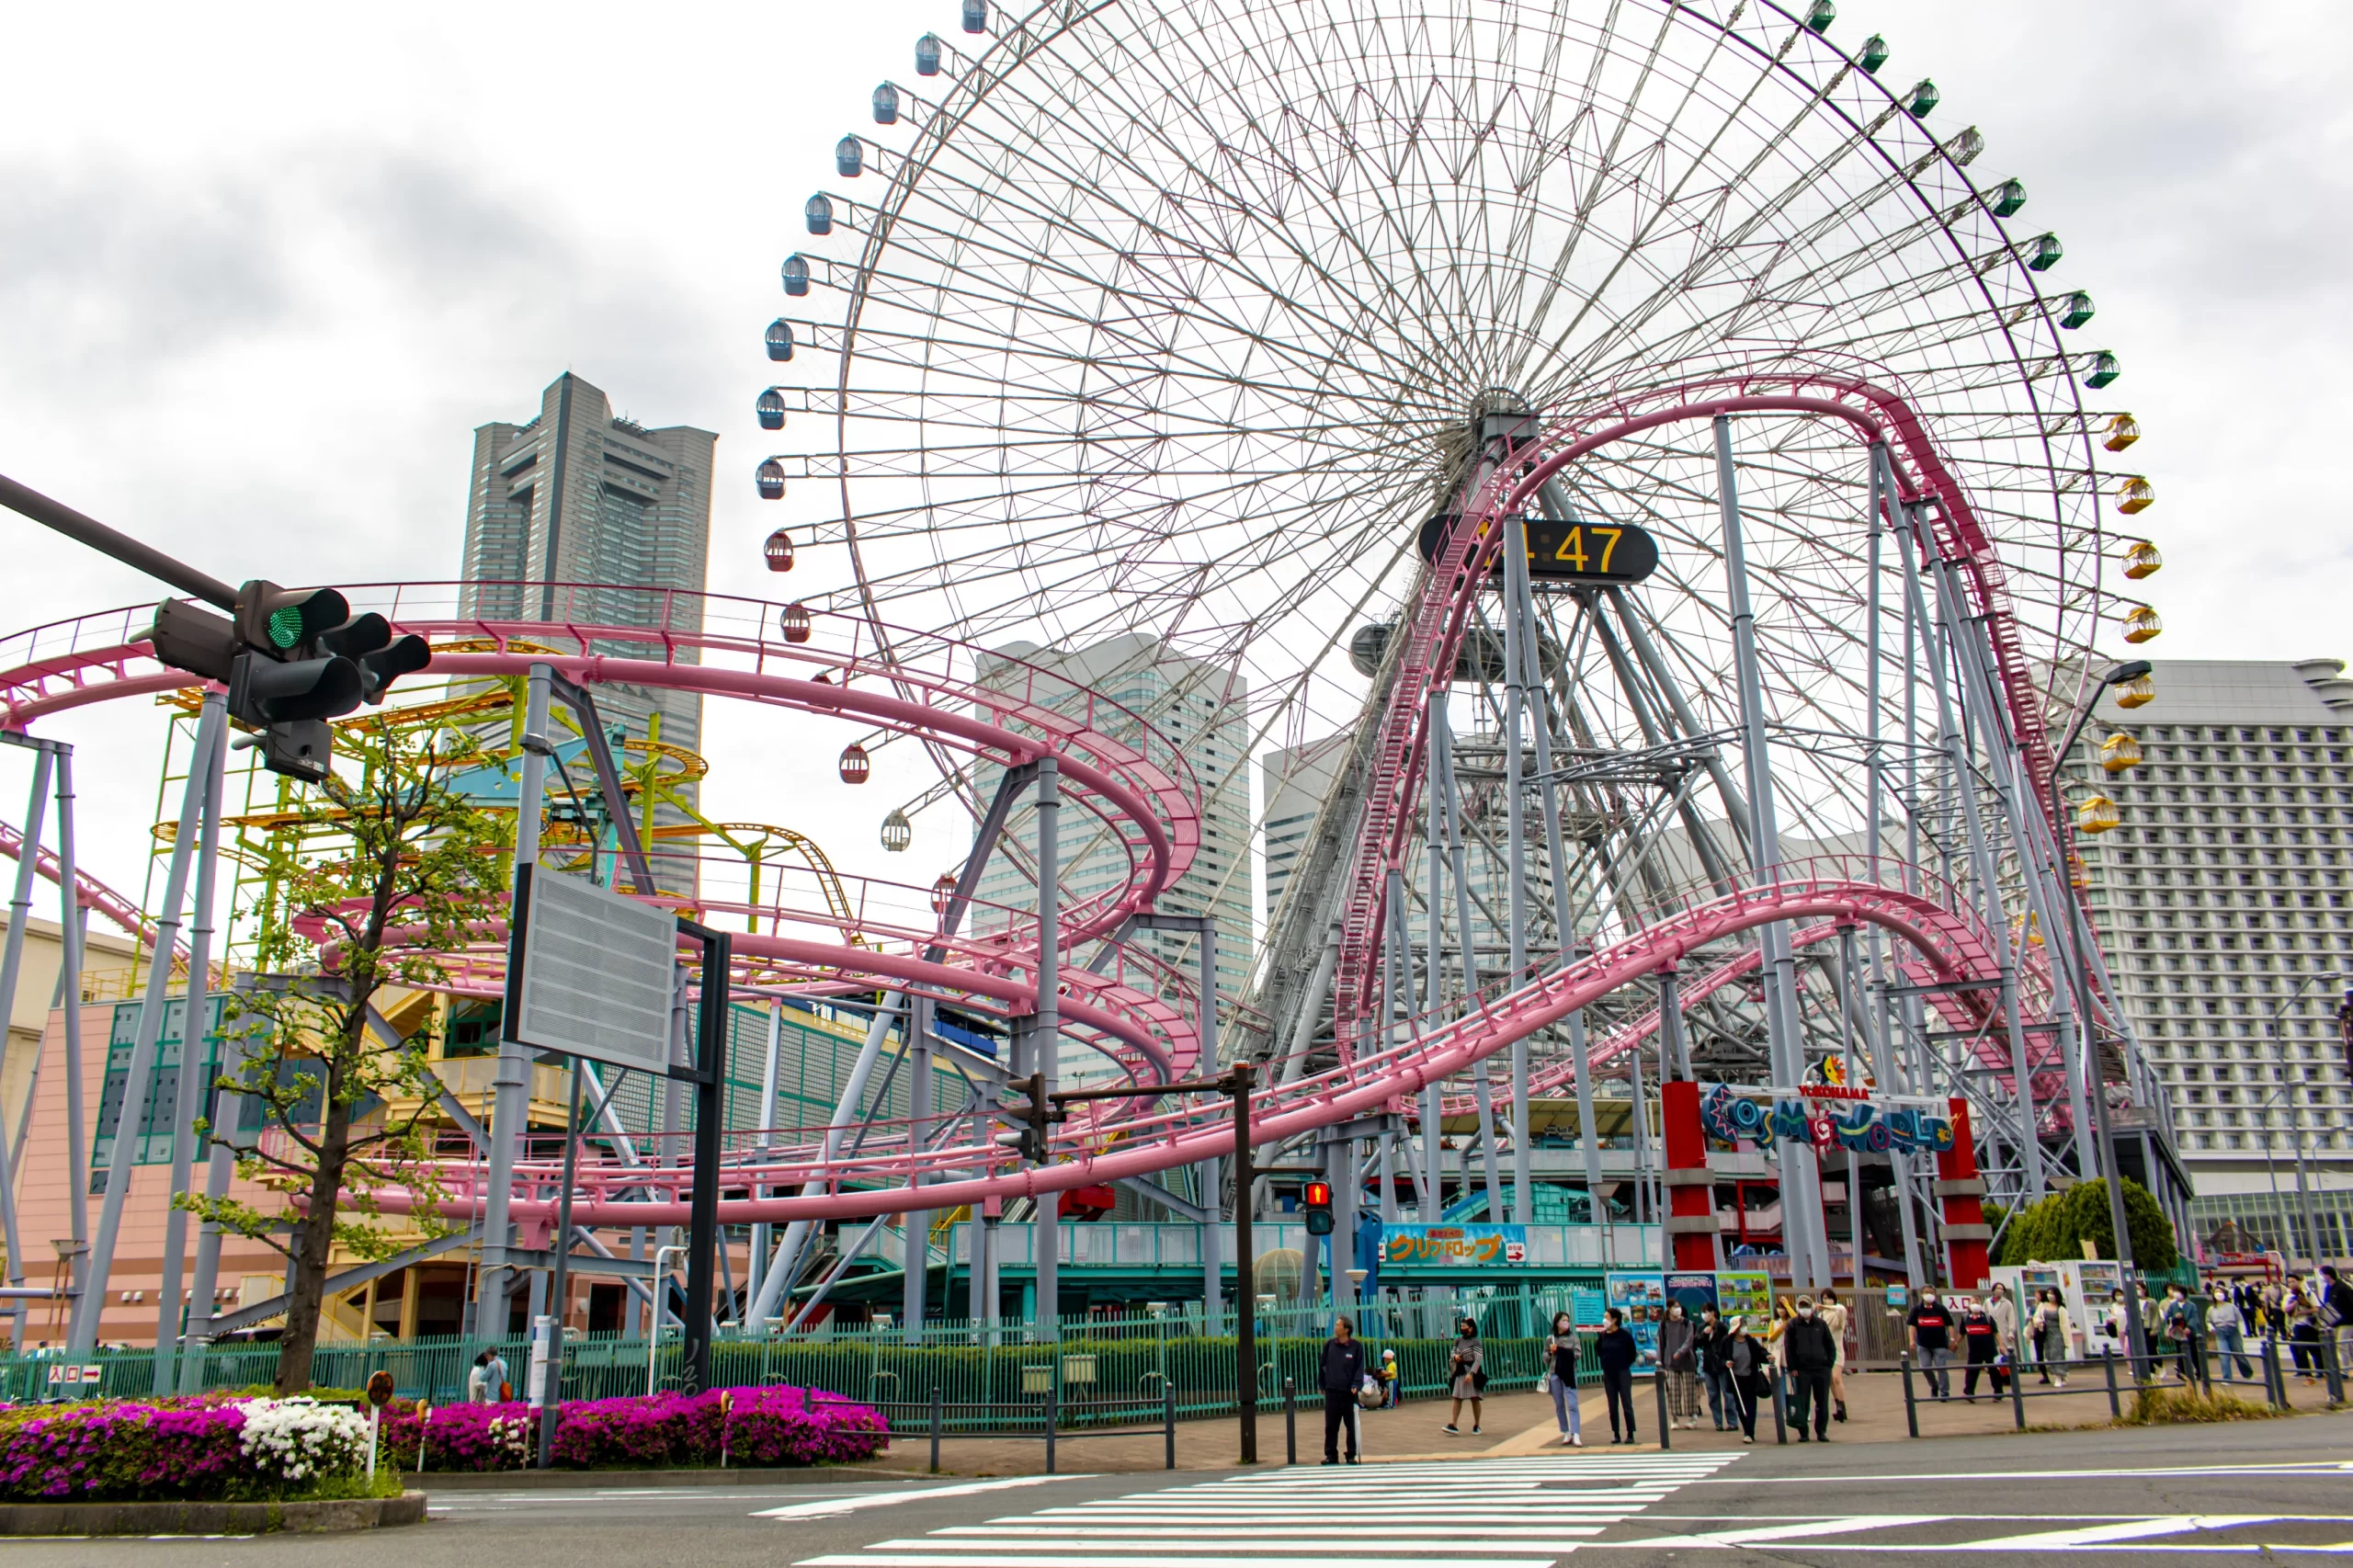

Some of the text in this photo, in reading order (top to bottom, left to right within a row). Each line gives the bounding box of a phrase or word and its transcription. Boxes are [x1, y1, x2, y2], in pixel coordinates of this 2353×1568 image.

[1798, 1085, 1870, 1100] YOKOHAMA
[1828, 1104, 1955, 1153] WORLD
[49, 1367, 79, 1381] 入口
